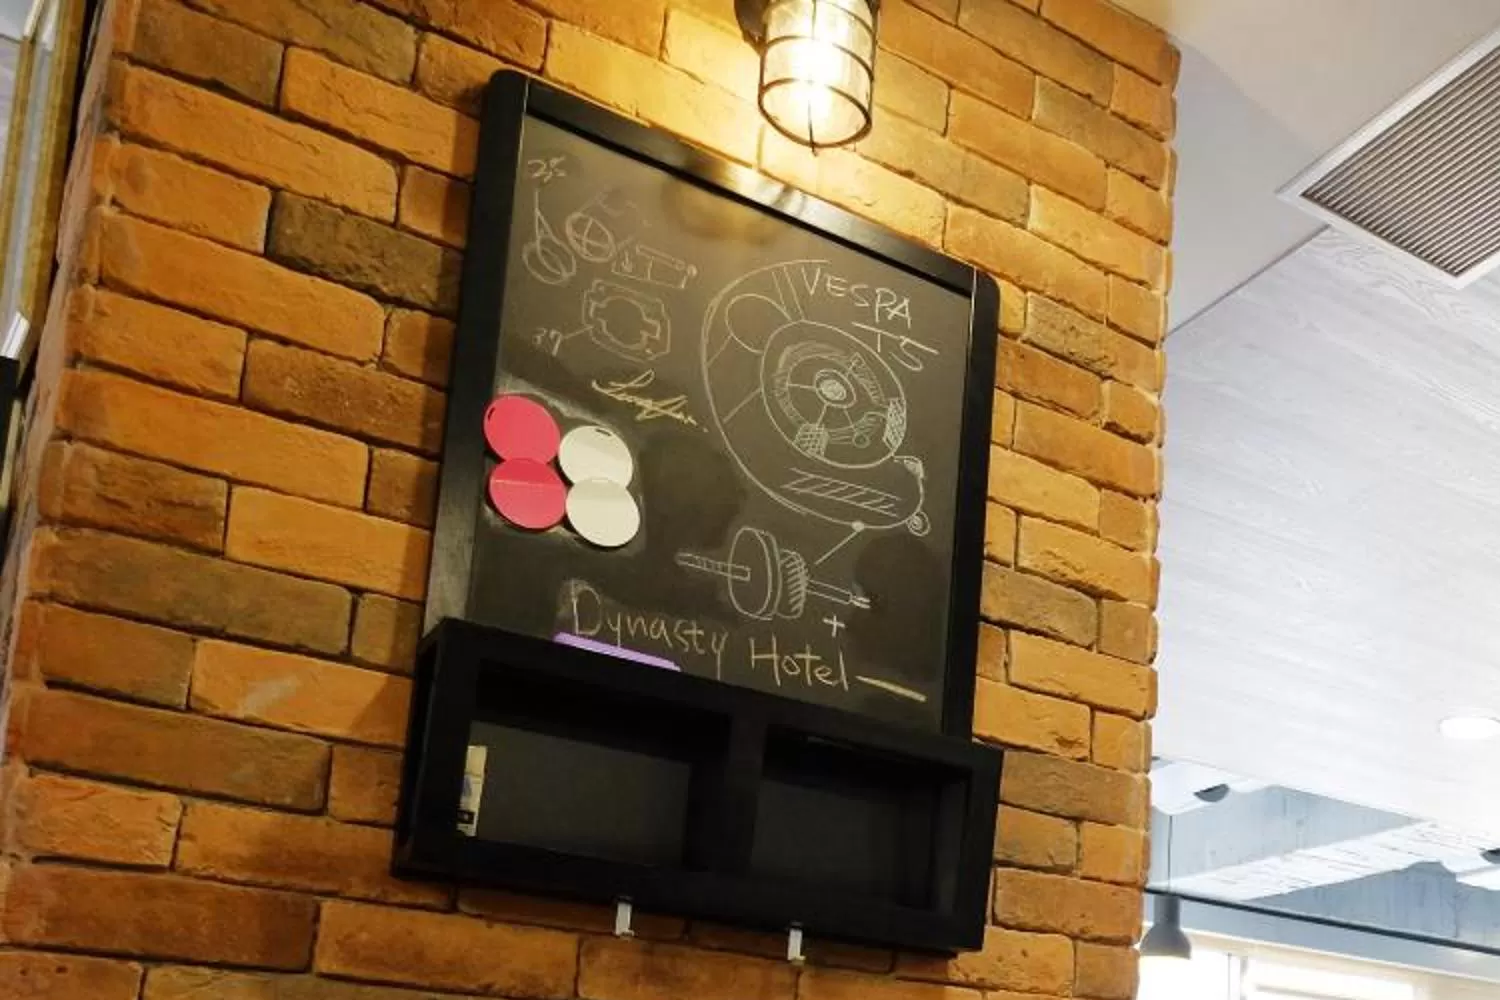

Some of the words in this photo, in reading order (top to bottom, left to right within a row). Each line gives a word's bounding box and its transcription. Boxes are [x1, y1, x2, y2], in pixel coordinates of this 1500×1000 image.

[801, 266, 912, 329] VESPA
[571, 579, 730, 681] Dynasty
[750, 635, 850, 691] Hotel
